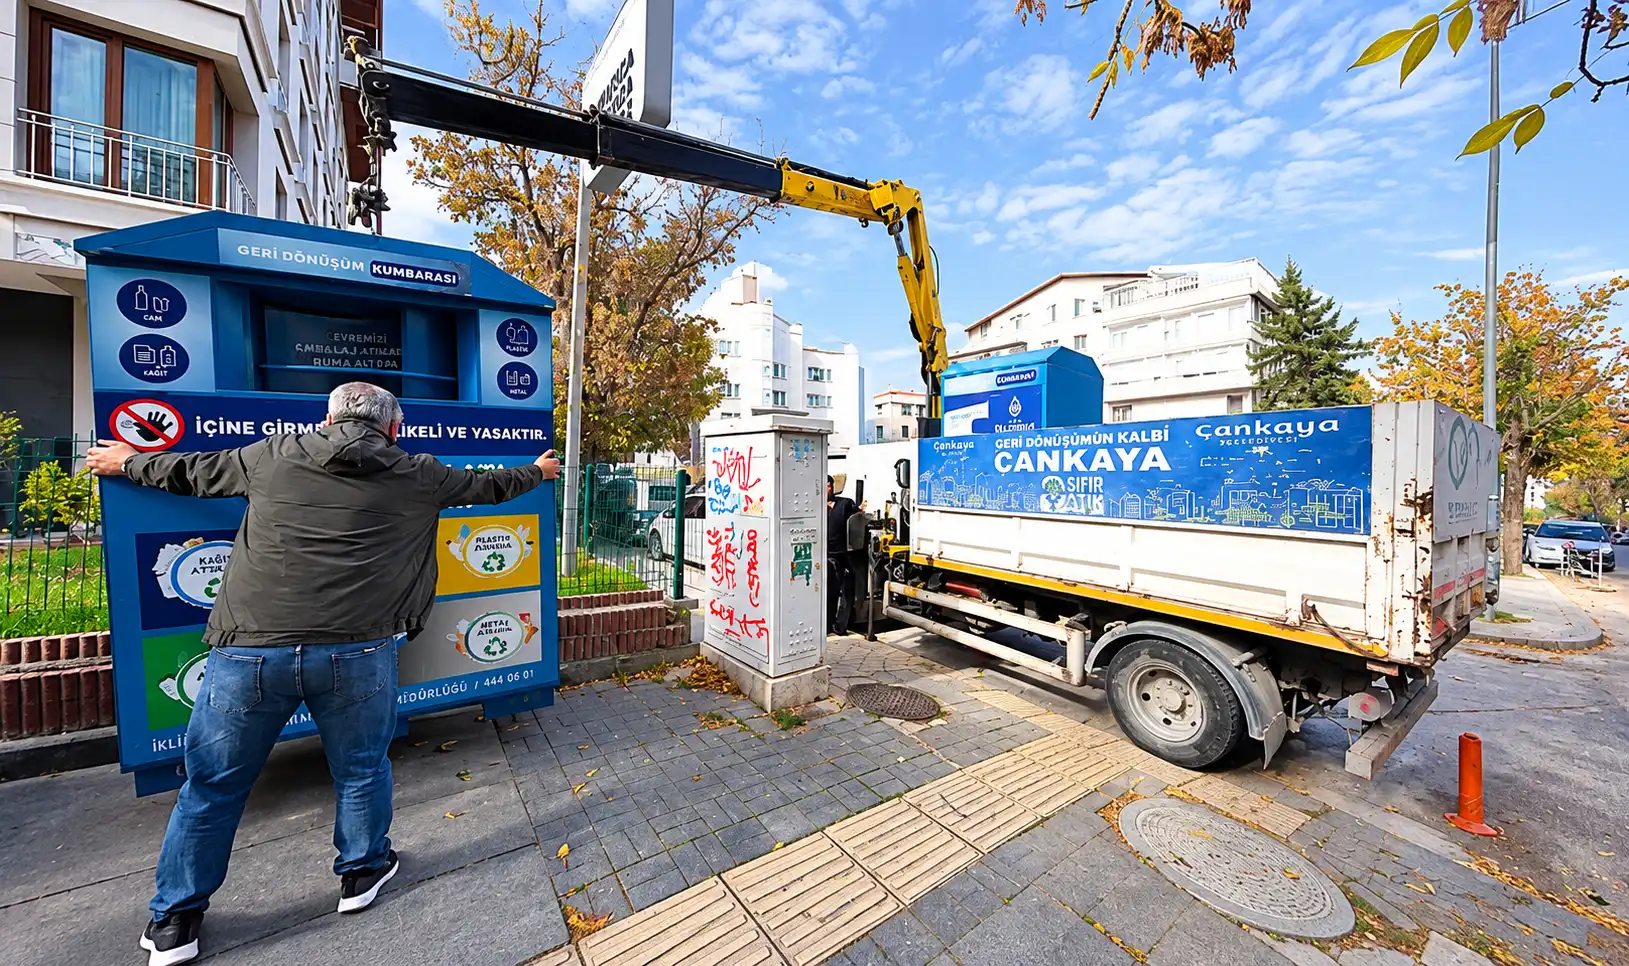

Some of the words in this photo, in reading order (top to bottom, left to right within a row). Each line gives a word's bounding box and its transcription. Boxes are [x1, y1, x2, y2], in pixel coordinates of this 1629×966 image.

[237, 244, 277, 260] GERİ
[282, 250, 365, 272] DÖNÜŞÜM
[372, 263, 456, 284] KUMBARASI
[143, 314, 163, 322] CAM
[195, 415, 255, 437] İÇİNE
[446, 426, 467, 439] VE
[471, 427, 547, 441] YASAKTIR.
[1195, 419, 1340, 441] Çankaya
[933, 440, 975, 452] Çankaya
[995, 435, 1023, 449] GERİ
[1026, 431, 1114, 449] DÖNÜŞÜMÜN
[1117, 425, 1170, 445] KALBİ
[994, 446, 1172, 476] ÇANKAYA
[1067, 476, 1104, 494] SIFIR
[1068, 494, 1104, 515] ATIK
[483, 675, 504, 687] 444
[507, 671, 520, 683] 06
[523, 669, 534, 679] 01
